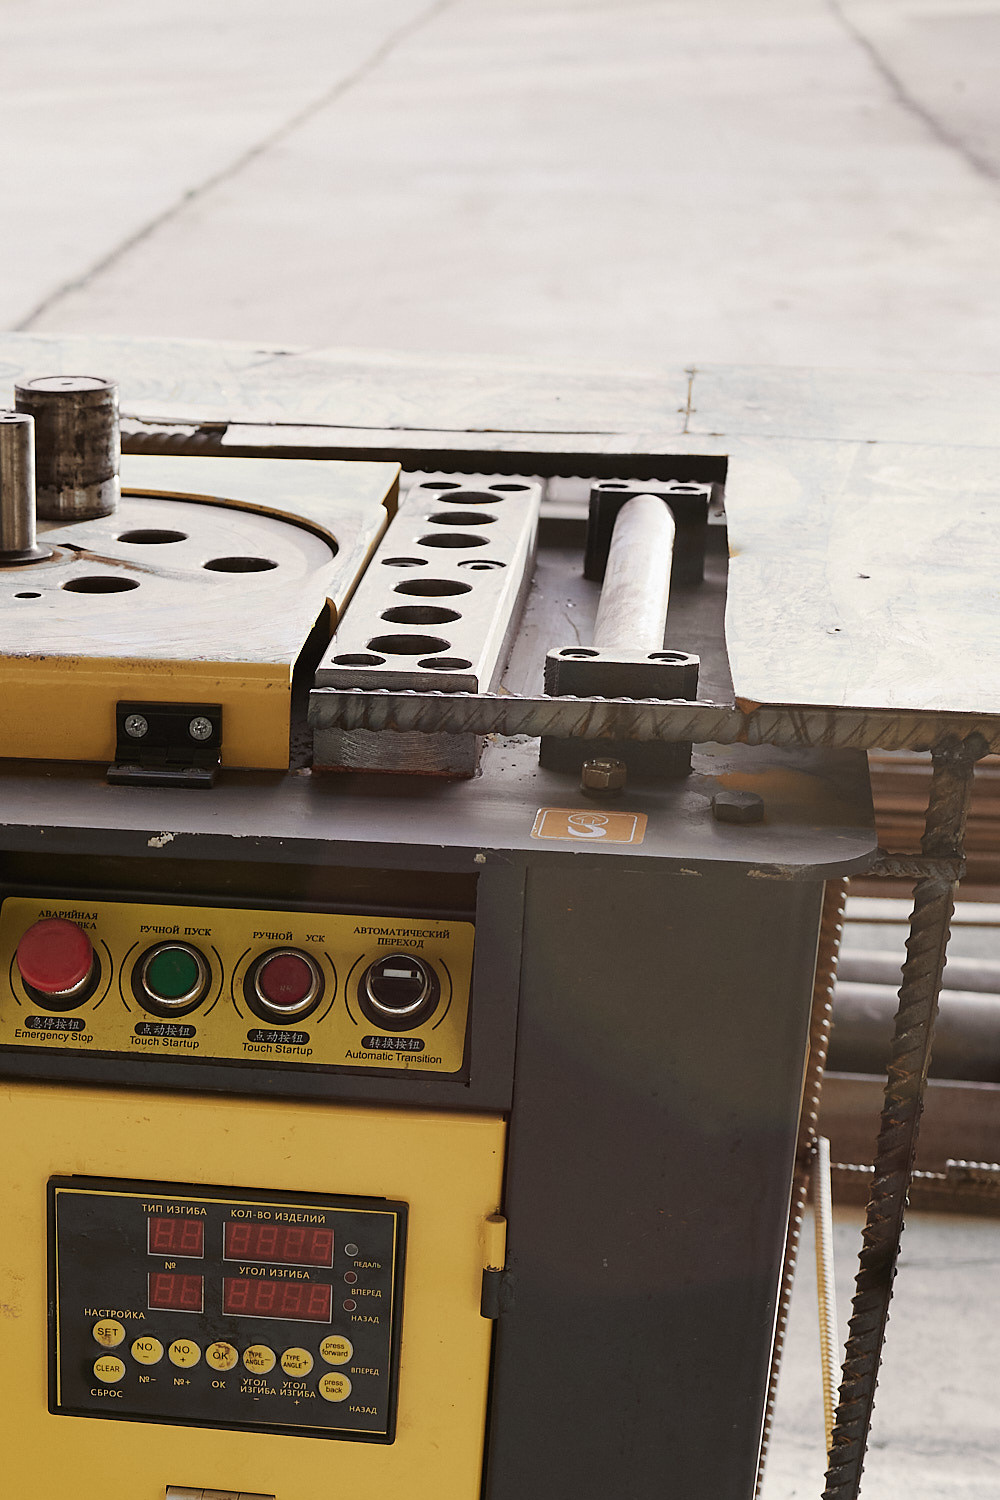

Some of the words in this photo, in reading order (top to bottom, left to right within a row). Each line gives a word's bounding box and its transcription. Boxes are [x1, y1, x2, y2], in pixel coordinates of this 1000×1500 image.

[38, 909, 99, 921] АВАРИЙНАЯ
[140, 924, 180, 935] РУЧНОЙ
[184, 927, 212, 937] ПУСК
[253, 930, 293, 941] РУЧНОЙ
[353, 926, 450, 939] АВТОМАТИЧЕСКИЙ
[377, 938, 425, 949] ПЕРЕХОД
[30, 1017, 80, 1030] 急停按钮
[140, 1023, 191, 1037] 点动按钮
[14, 1029, 70, 1043] Emergency
[71, 1032, 94, 1043] Stop
[253, 1030, 304, 1044] 点动按钮
[129, 1036, 160, 1047] Touch
[162, 1038, 200, 1050] Startup
[368, 1036, 420, 1050] 转换按钮
[242, 1042, 273, 1053] Touch
[275, 1045, 313, 1057] Startup
[345, 1050, 393, 1062] Automatic
[395, 1052, 442, 1064] Transition
[141, 1203, 163, 1213] ТИП
[166, 1205, 208, 1216] ИЗГИБА
[230, 1209, 272, 1220] КОЛ-ВО
[274, 1212, 326, 1224] ИЗДЕЛИЙ
[164, 1261, 177, 1270] №
[353, 1260, 382, 1269] ПЕДАЛЬ
[239, 1266, 266, 1276] УГОЛ
[269, 1269, 310, 1280] ИЗГИБА
[351, 1288, 382, 1298] ВПЕРЕД
[84, 1308, 146, 1320] НАСТРОЙКА
[351, 1315, 380, 1324] НАЗАД
[97, 1327, 119, 1337] SET
[325, 1342, 345, 1351] press
[212, 1351, 228, 1360] OK
[248, 1350, 263, 1359] TYPE
[322, 1348, 349, 1357] forward
[245, 1357, 265, 1366] ANGLE
[285, 1354, 301, 1362] TYPE
[96, 1364, 120, 1373] CLEAR
[282, 1361, 303, 1369] ANGLE
[350, 1367, 380, 1376] ВПЕРЕД
[242, 1378, 267, 1388] УГОЛ
[282, 1381, 307, 1391] УГОЛ
[324, 1379, 344, 1387] press
[90, 1388, 124, 1398] СБРОС
[240, 1386, 277, 1396] ИЗГИБА
[279, 1389, 316, 1399] ИЗГИБА
[325, 1386, 343, 1394] back
[349, 1405, 378, 1415] НАЗАД
